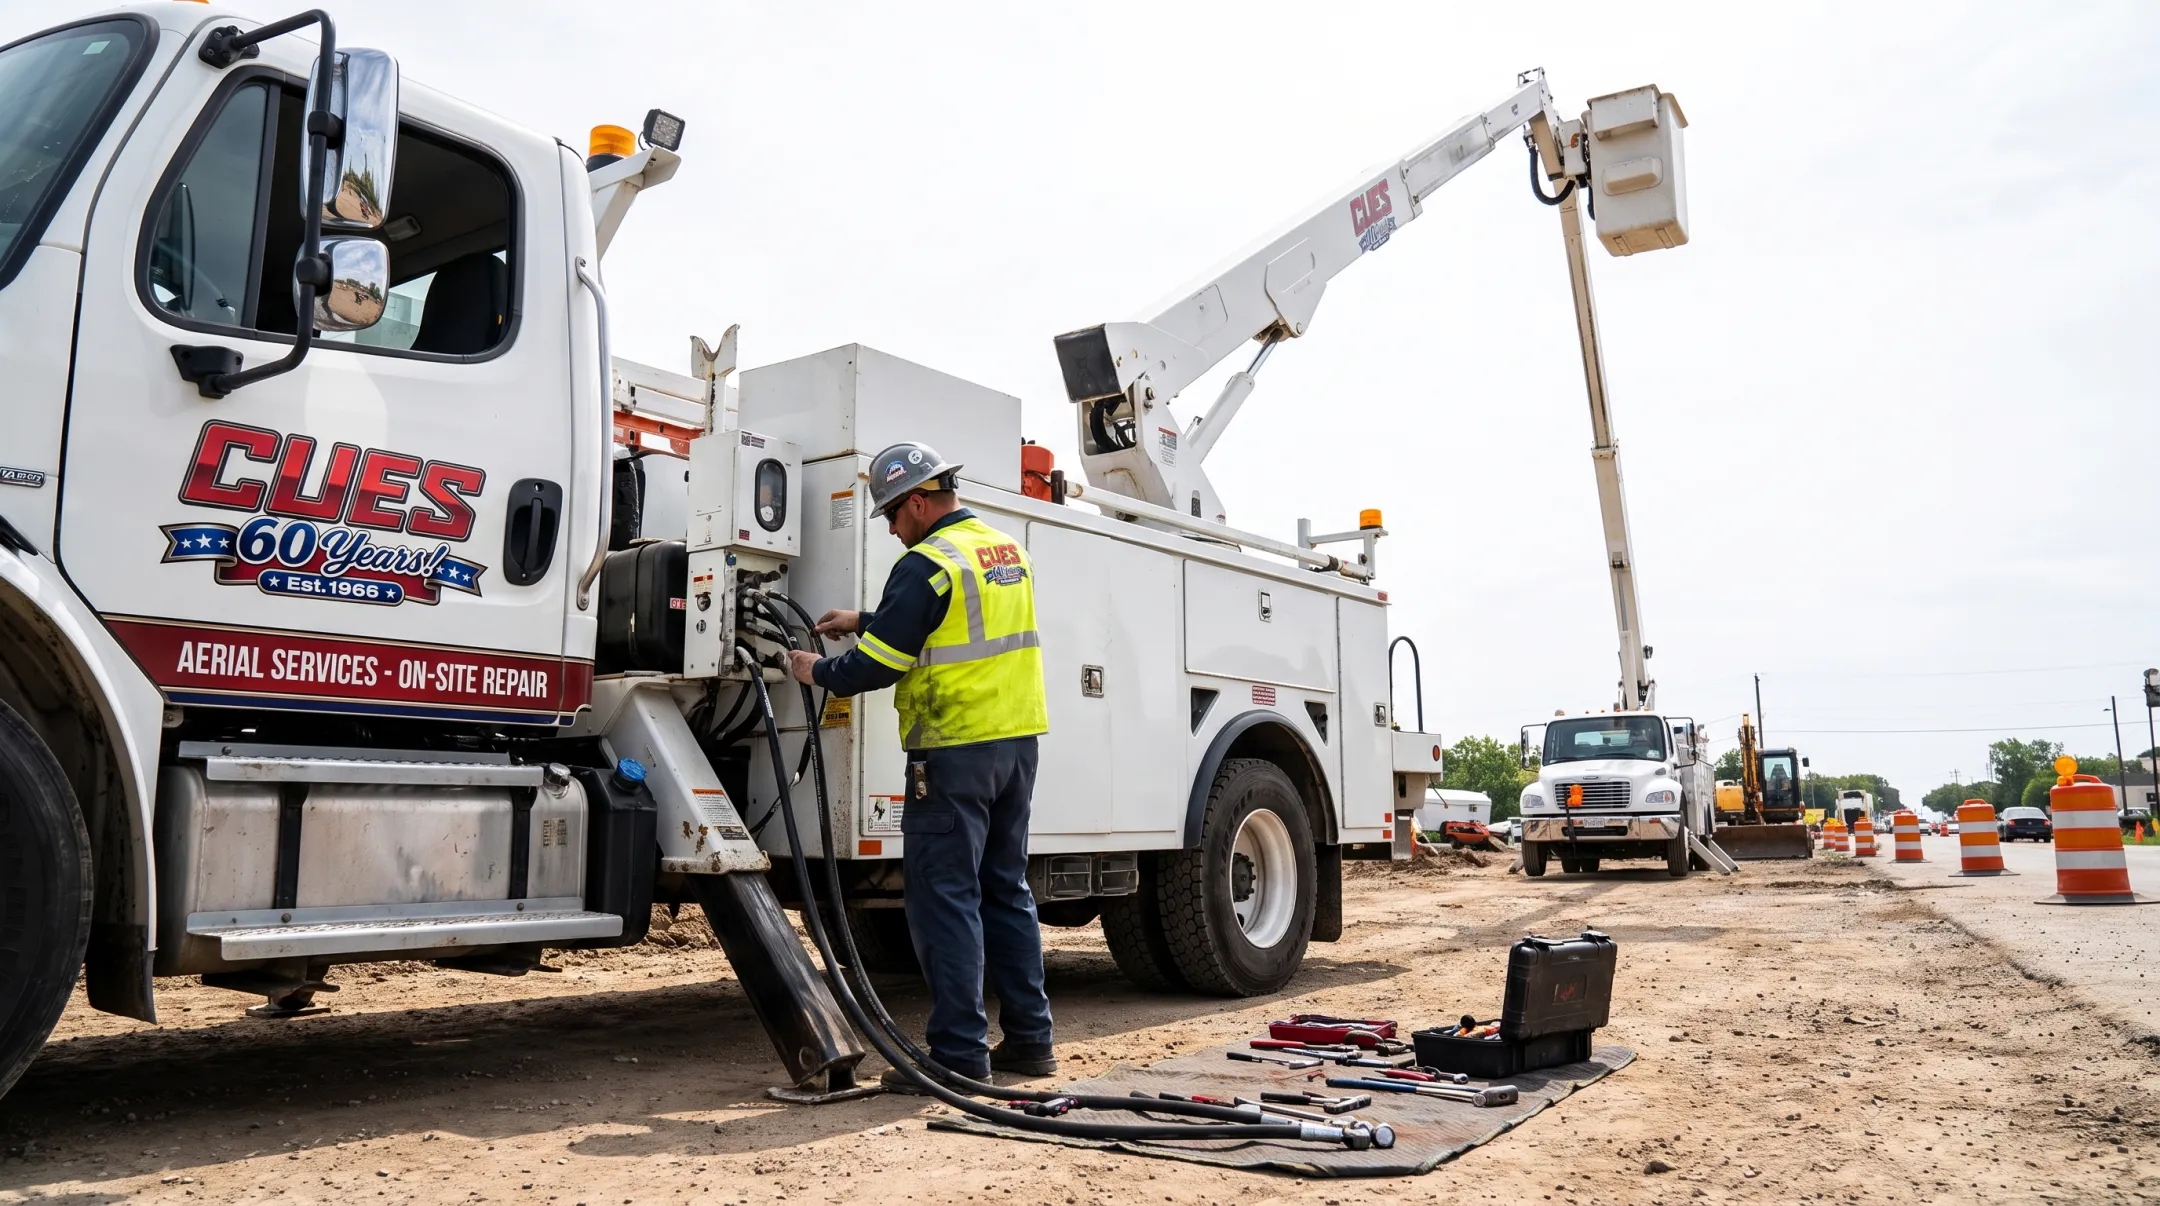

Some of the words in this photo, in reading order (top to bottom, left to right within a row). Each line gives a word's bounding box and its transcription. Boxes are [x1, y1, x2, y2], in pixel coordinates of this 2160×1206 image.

[1349, 177, 1393, 238] CUES
[178, 418, 487, 543] CUES
[237, 515, 320, 567] 60
[319, 526, 451, 578] Years!
[975, 543, 1022, 569] CUES
[176, 640, 265, 679] AERIAL
[270, 648, 379, 687] SERVICES
[398, 659, 479, 694] ON-SITE
[482, 666, 548, 698] REPAIR
